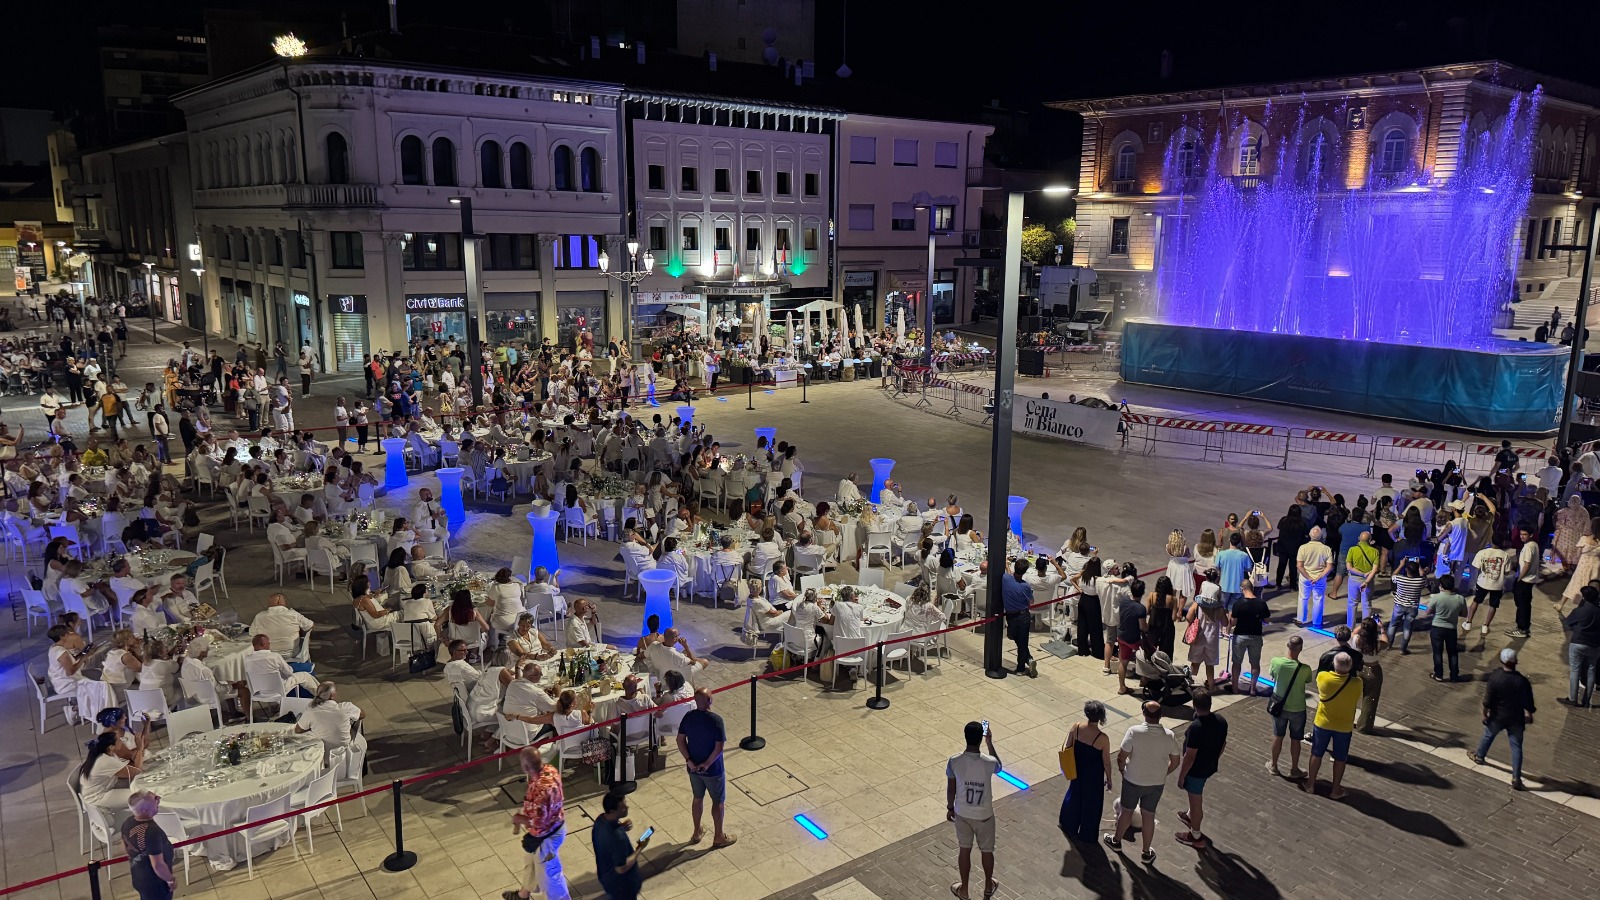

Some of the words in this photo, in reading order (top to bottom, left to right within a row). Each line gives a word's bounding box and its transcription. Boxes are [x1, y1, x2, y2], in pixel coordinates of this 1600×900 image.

[1026, 400, 1057, 420] Cena
[1024, 413, 1034, 429] in
[1036, 415, 1084, 438] Bianco
[966, 788, 984, 805] 07
